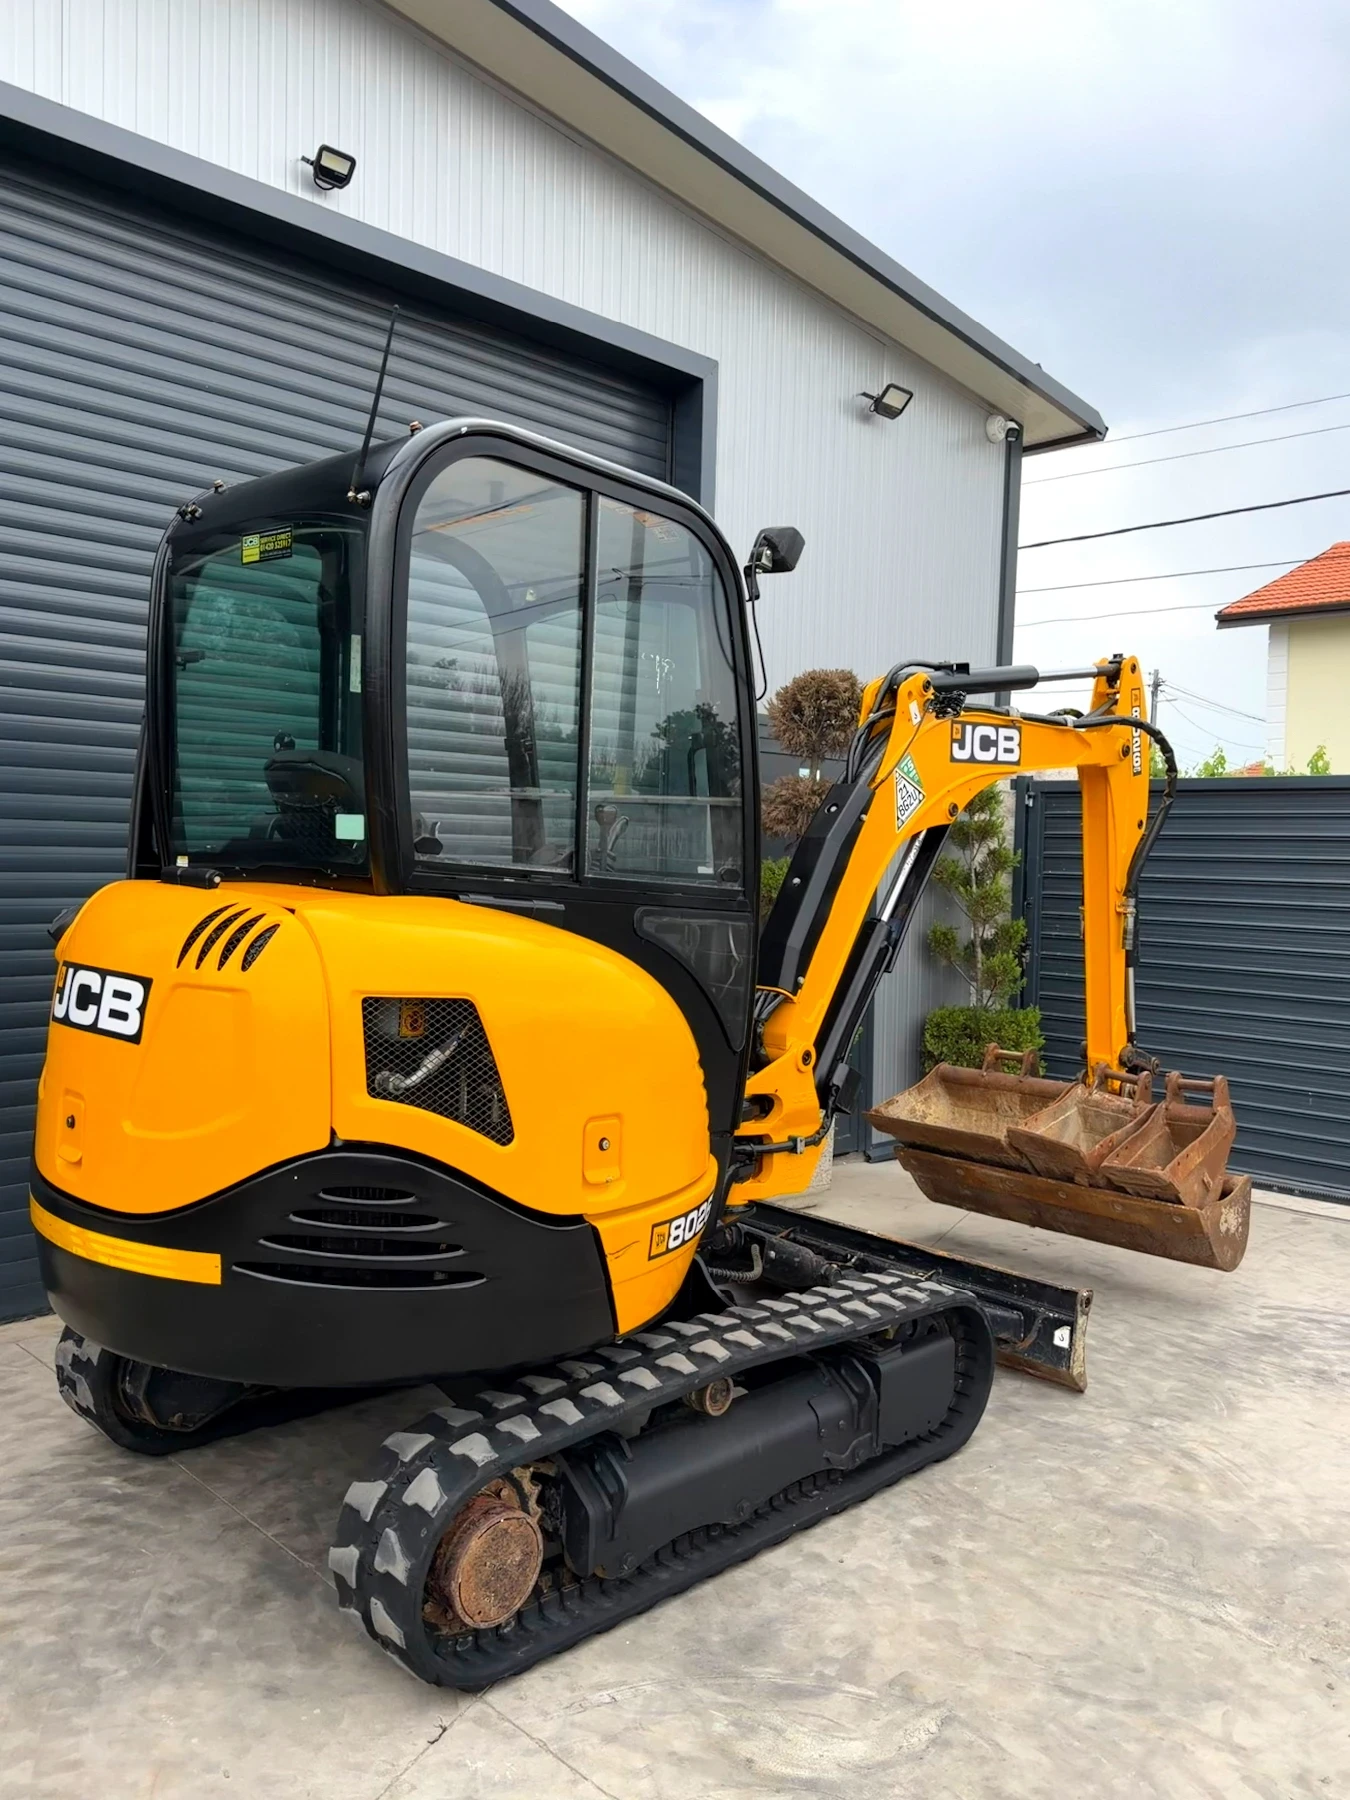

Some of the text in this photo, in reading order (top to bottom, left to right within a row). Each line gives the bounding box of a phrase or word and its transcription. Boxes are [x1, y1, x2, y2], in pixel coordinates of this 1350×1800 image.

[952, 724, 1020, 763] JCB
[898, 783, 909, 800] 21
[54, 967, 145, 1036] JCB
